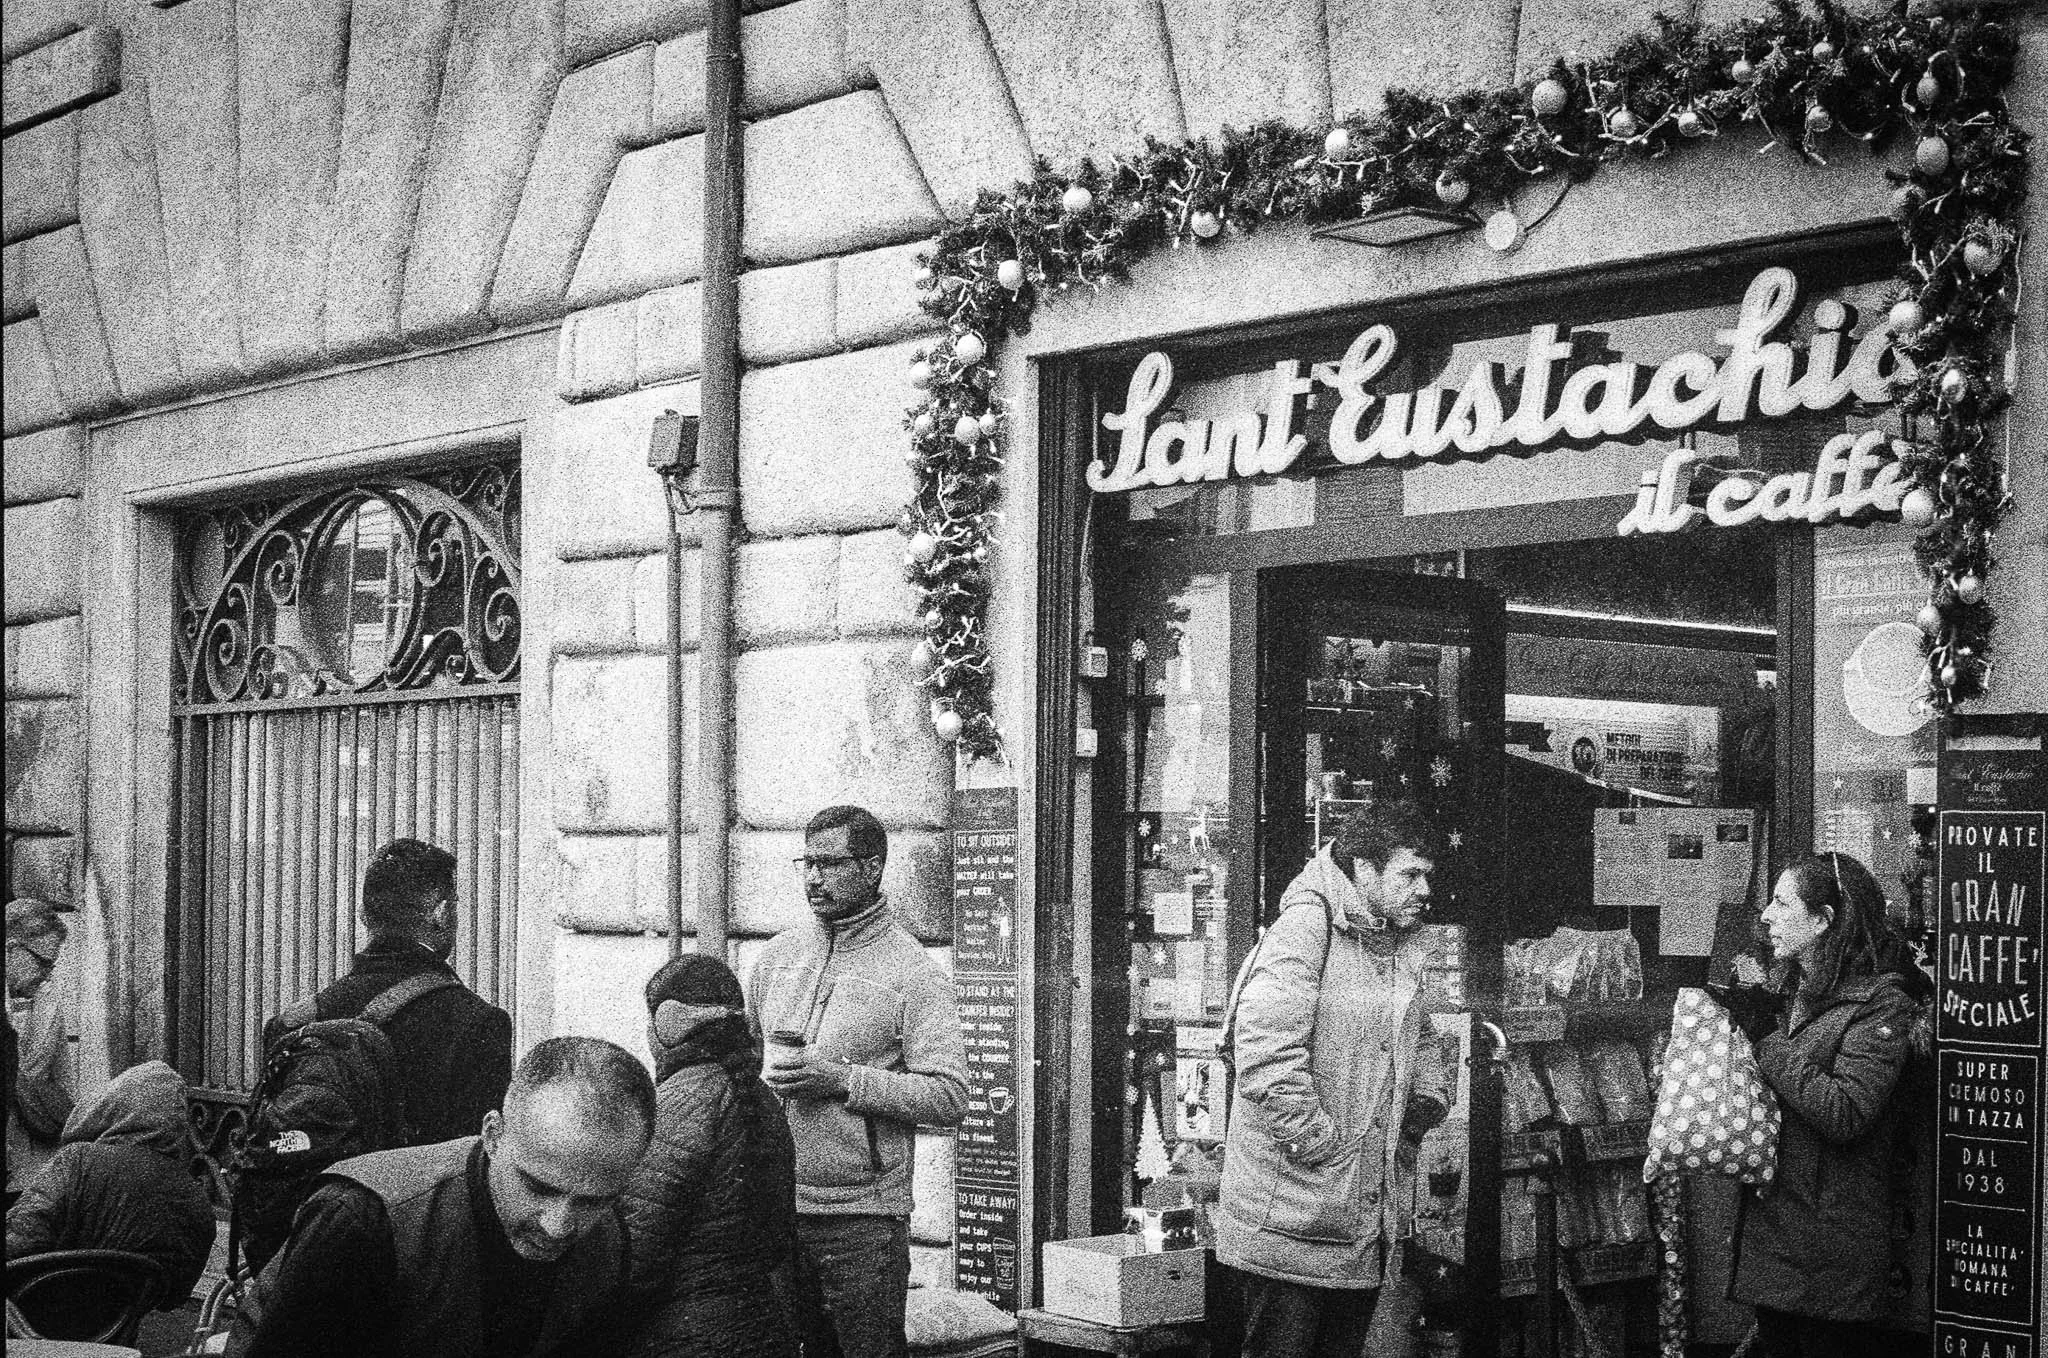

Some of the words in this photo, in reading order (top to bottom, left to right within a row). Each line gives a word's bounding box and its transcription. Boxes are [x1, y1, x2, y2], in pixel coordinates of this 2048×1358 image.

[1617, 448, 1705, 537] il
[1948, 826, 2037, 847] PROVATE
[1978, 852, 1995, 874] IL
[1951, 879, 2026, 926] GRAN
[1943, 990, 2035, 1027] SPECIALE
[1957, 1061, 2009, 1080] SUPER
[1967, 1109, 2024, 1129] TAZZA
[269, 1138, 299, 1149] NORTH
[1963, 1148, 1998, 1168] DAL
[1957, 1173, 2005, 1194] 1938
[958, 1192, 968, 1205] TO
[969, 1193, 987, 1207] TAKE
[989, 1195, 1016, 1210] AWAY?
[1968, 1224, 1983, 1239] LA
